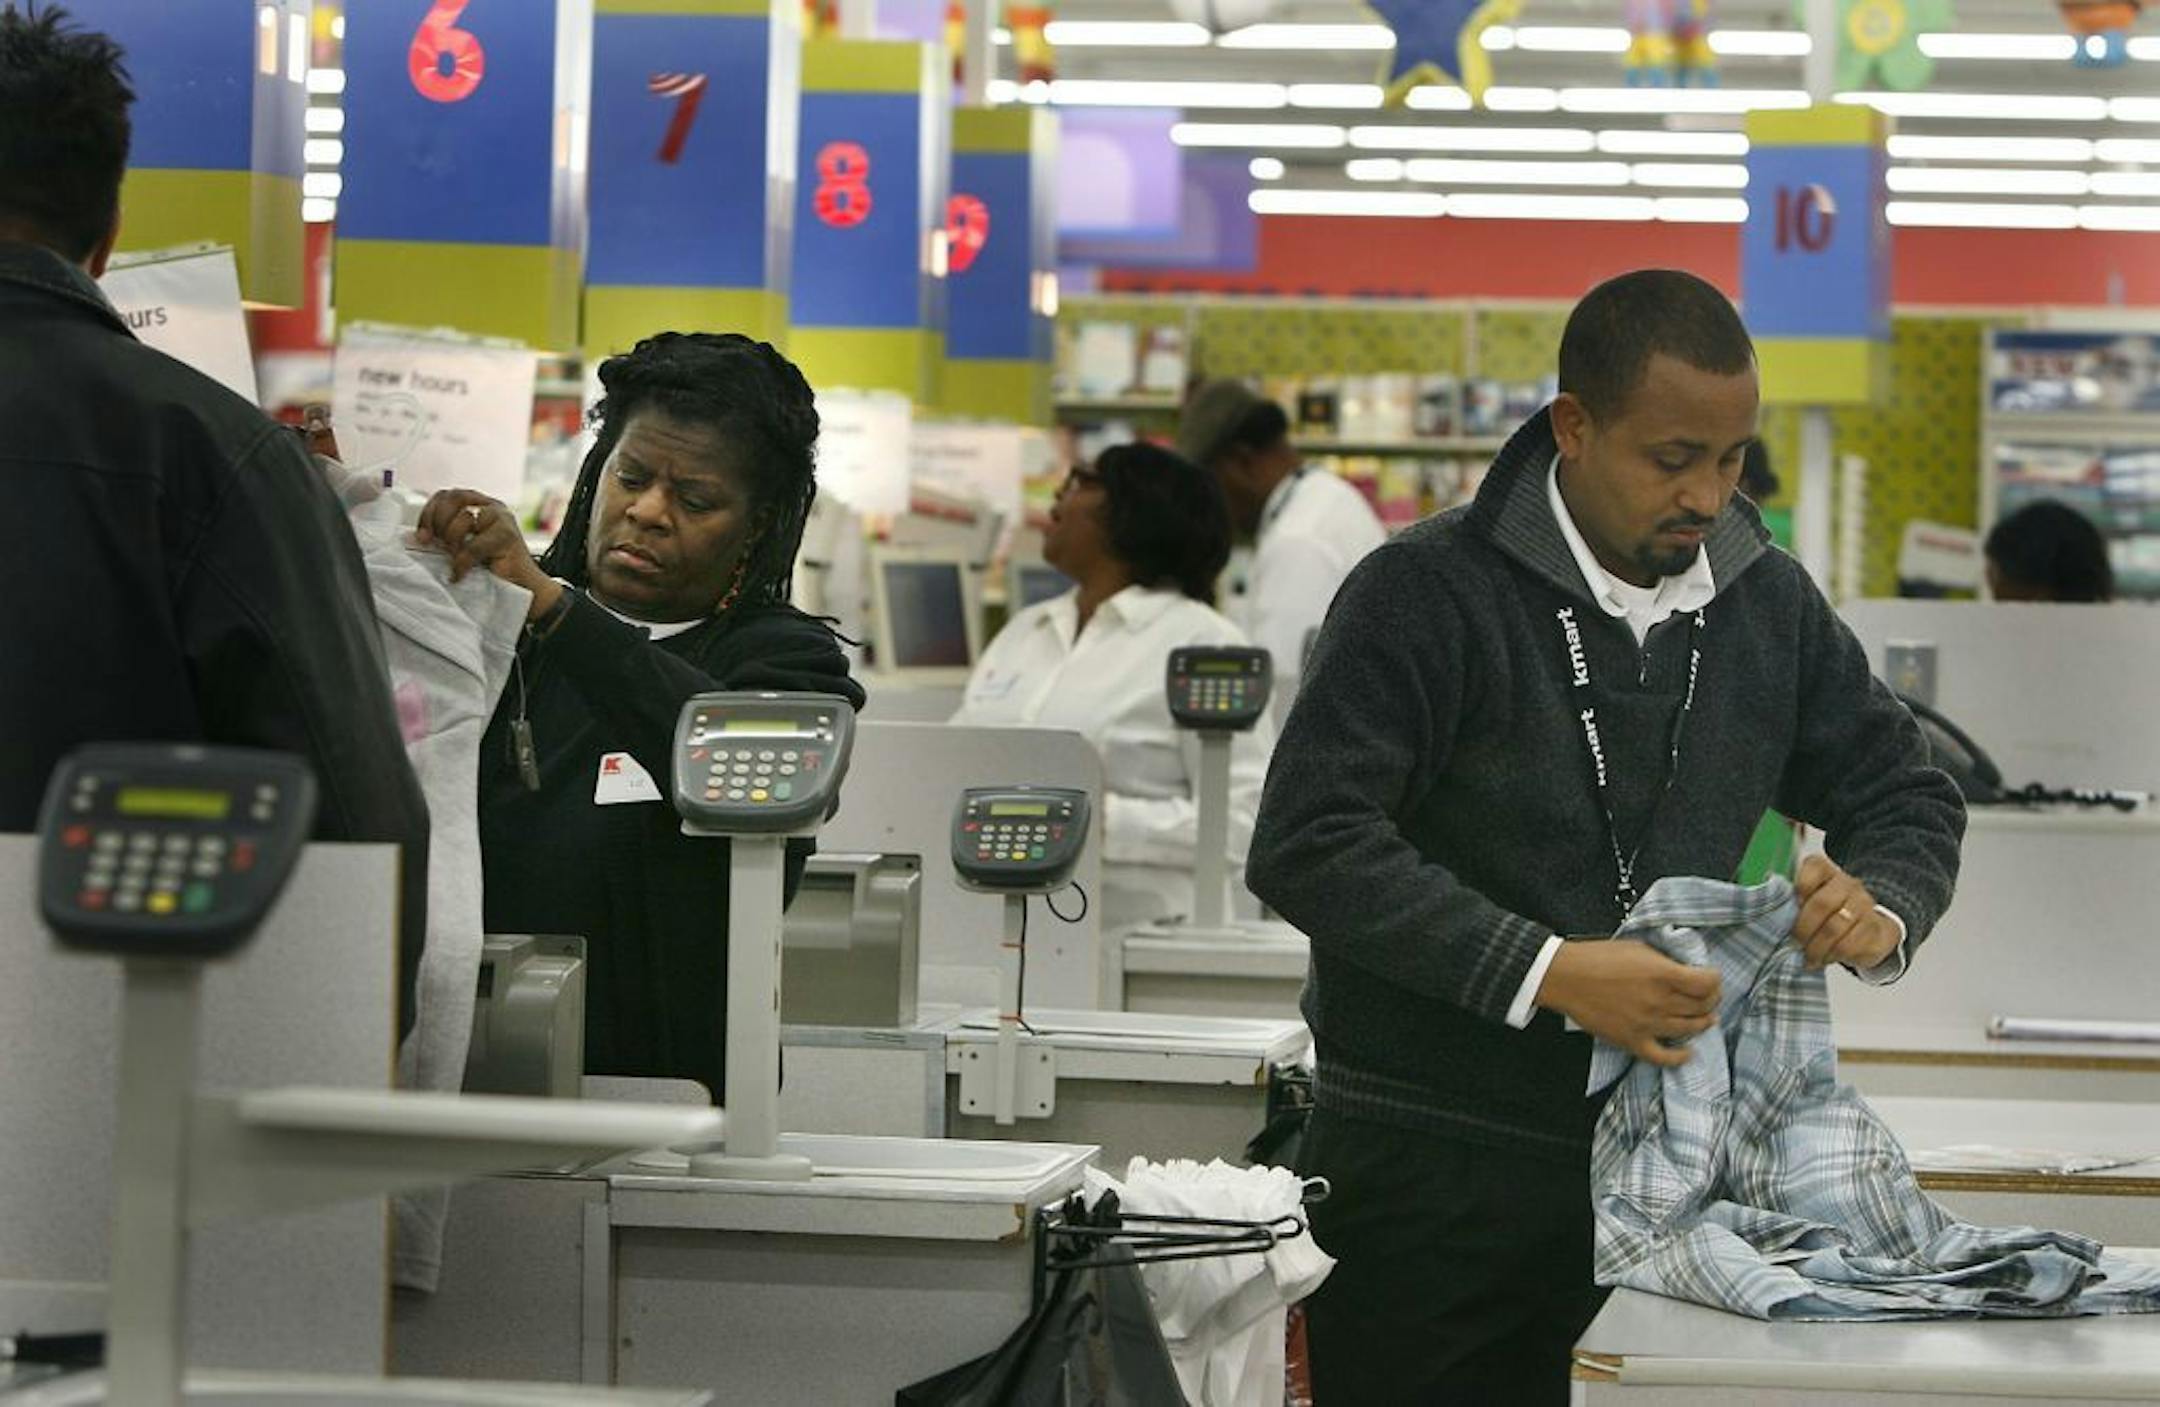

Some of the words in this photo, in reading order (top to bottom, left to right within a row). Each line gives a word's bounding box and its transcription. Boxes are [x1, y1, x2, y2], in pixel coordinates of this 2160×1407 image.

[408, 0, 485, 103] 6
[647, 73, 708, 164] 7
[814, 141, 871, 228] 8
[1774, 184, 1836, 254] 10
[945, 193, 989, 272] 9
[358, 368, 401, 385] new
[409, 371, 469, 396] hours
[1556, 606, 1590, 687] kmart
[1580, 707, 1607, 787] kmart
